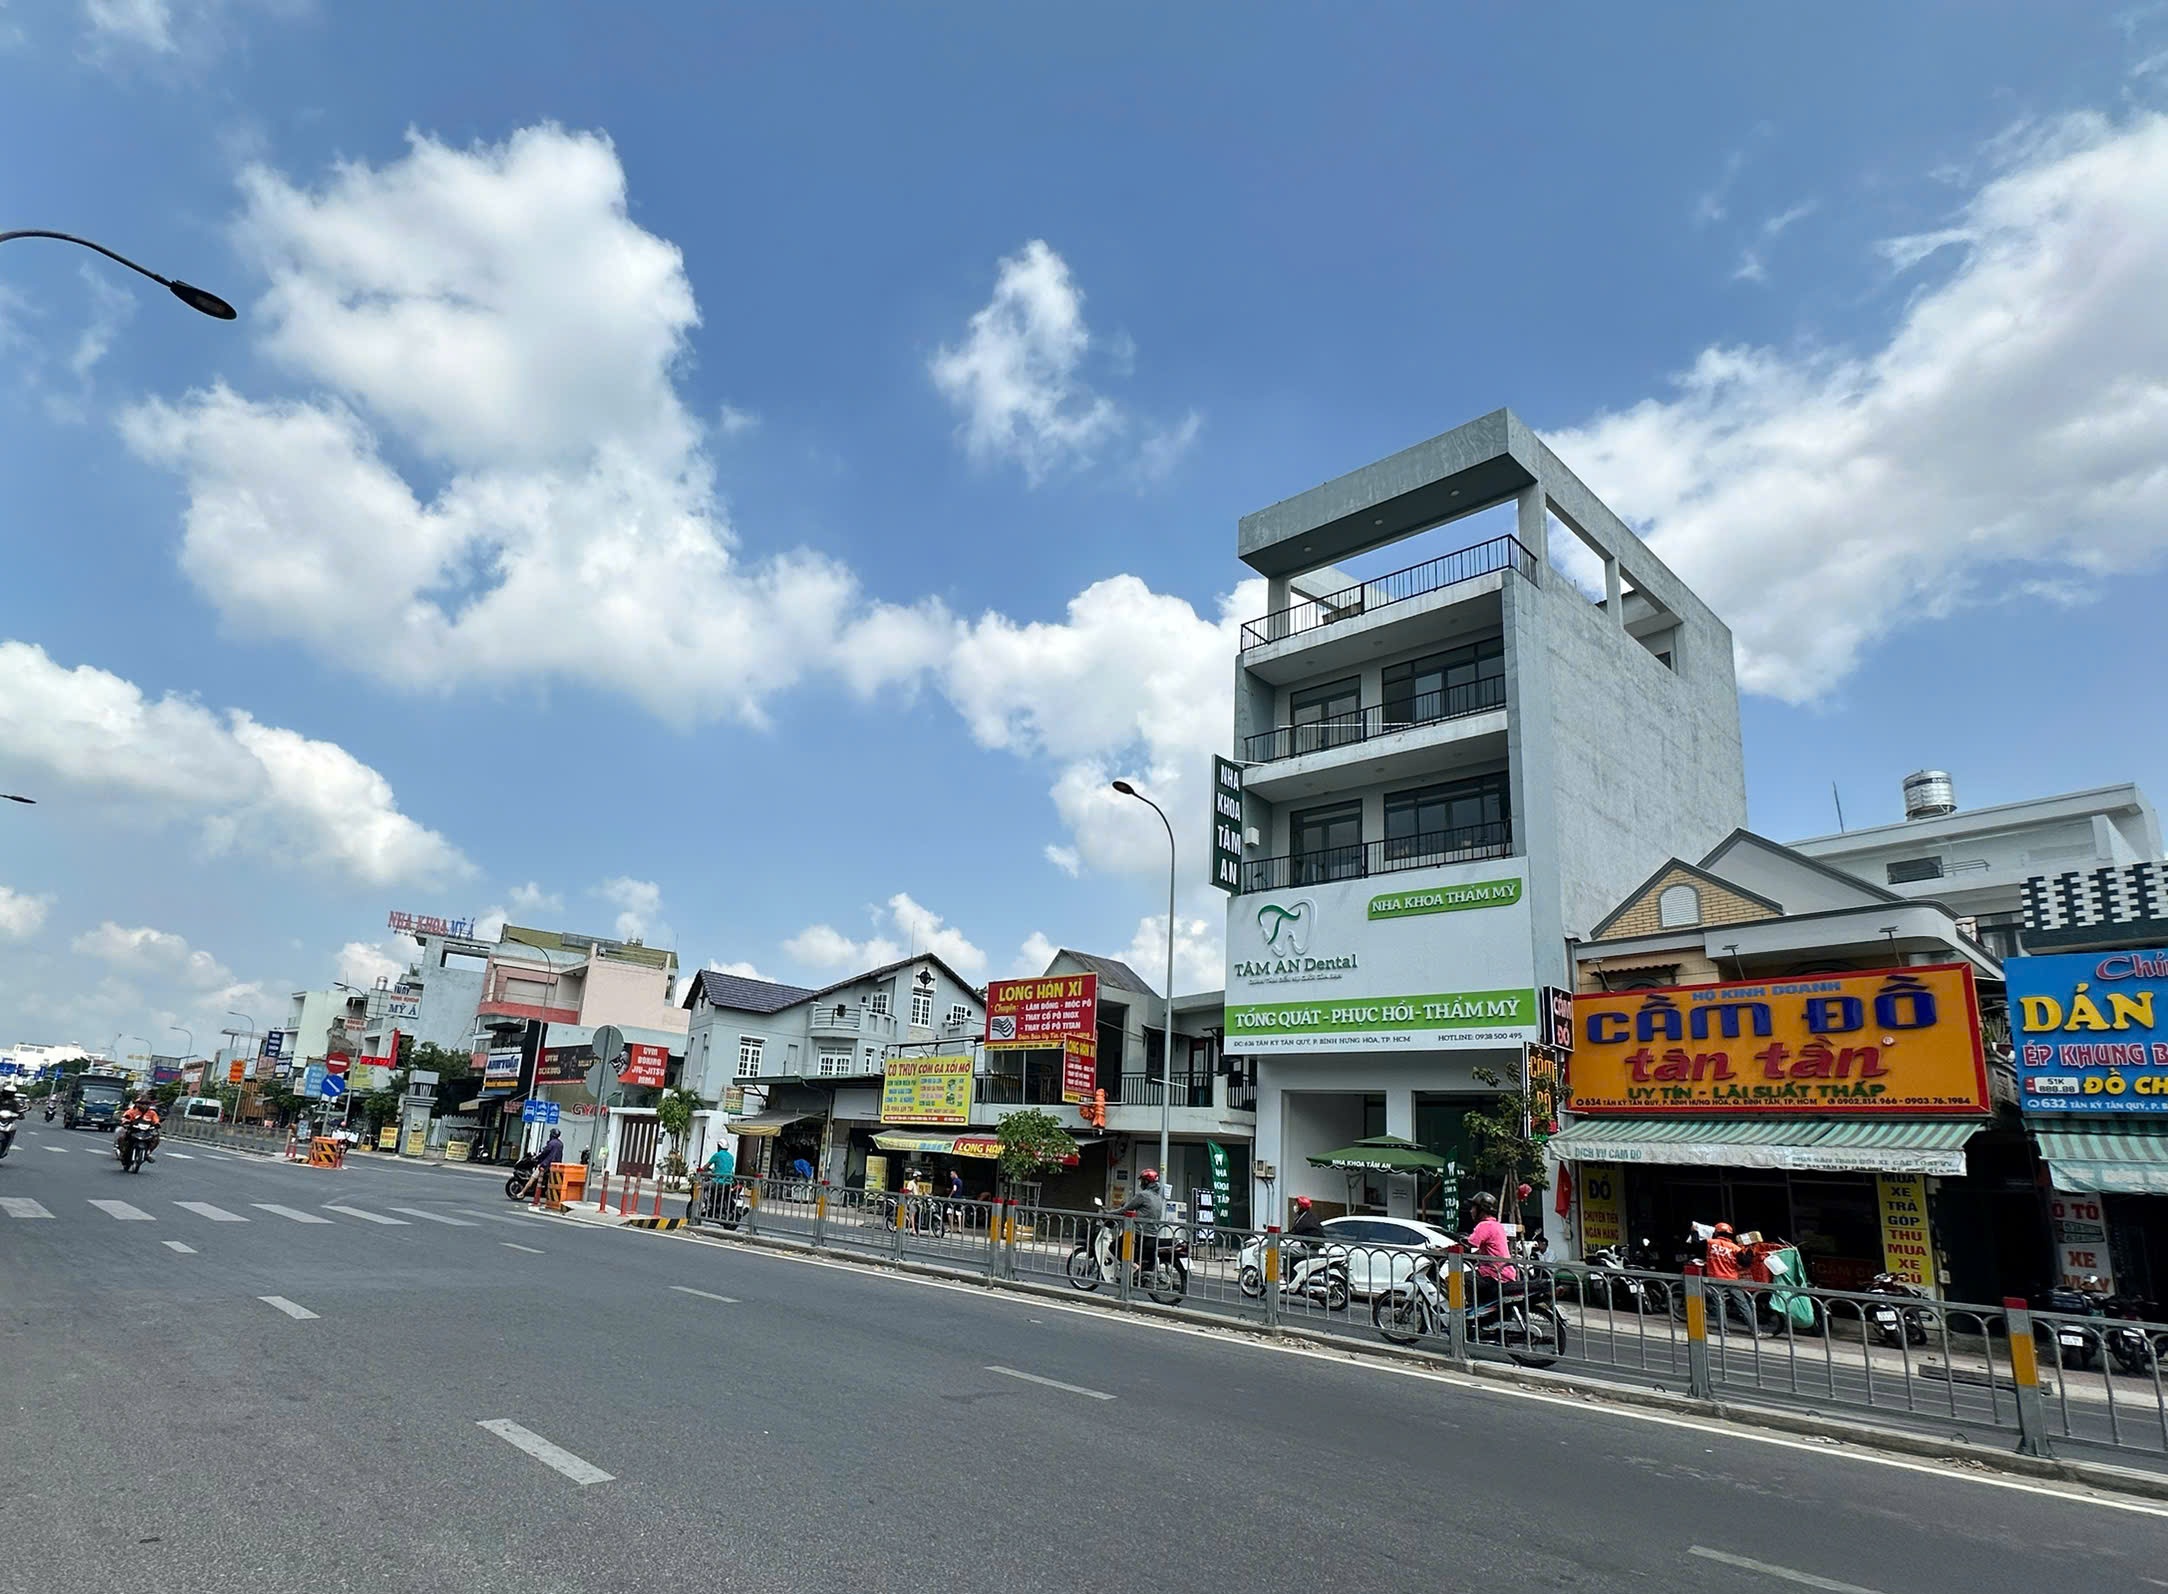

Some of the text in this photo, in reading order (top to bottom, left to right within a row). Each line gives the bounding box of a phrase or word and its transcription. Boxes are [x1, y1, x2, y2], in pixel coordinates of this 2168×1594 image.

[1220, 764, 1239, 791] NHA
[1217, 792, 1241, 822] KHOA
[1217, 824, 1241, 856] TÂM
[1220, 858, 1237, 885] AN
[1371, 899, 1401, 913] NHA
[1404, 894, 1444, 908] KHOA
[1234, 954, 1358, 977] TÂM AN Dental
[999, 986, 1033, 1002] LONG
[1720, 987, 1766, 999] KINH
[1771, 981, 1841, 995] DOANH
[1801, 974, 1938, 1033] ĐỒ
[2020, 983, 2155, 1032] DÁN
[1278, 1008, 1322, 1028] QUÁT
[1330, 1006, 1379, 1027] PHỤC
[1509, 1032, 1523, 1040] 495
[2022, 1040, 2054, 1067] ÉP
[2058, 1043, 2148, 1069] KHUNG
[1628, 1080, 1886, 1099] UY TÍN LÃI SUẤT THẤP
[2083, 1067, 2127, 1095] ĐỒ
[1585, 1098, 1601, 1106] 634
[2041, 1098, 2068, 1109] 632
[2070, 1100, 2088, 1110] TÂN
[2105, 1100, 2124, 1110] TÂN
[958, 1142, 984, 1153] LONG
[1347, 1160, 1366, 1168] KHOA
[1366, 1160, 1380, 1169] TÂM
[1882, 1173, 1918, 1184] MUA
[1891, 1187, 1912, 1198] XE
[2071, 1201, 2099, 1221] TÔ
[1889, 1229, 1923, 1242] THU
[1888, 1243, 1927, 1257] MUA
[2068, 1250, 2098, 1269] XE
[1898, 1258, 1921, 1270] XE
